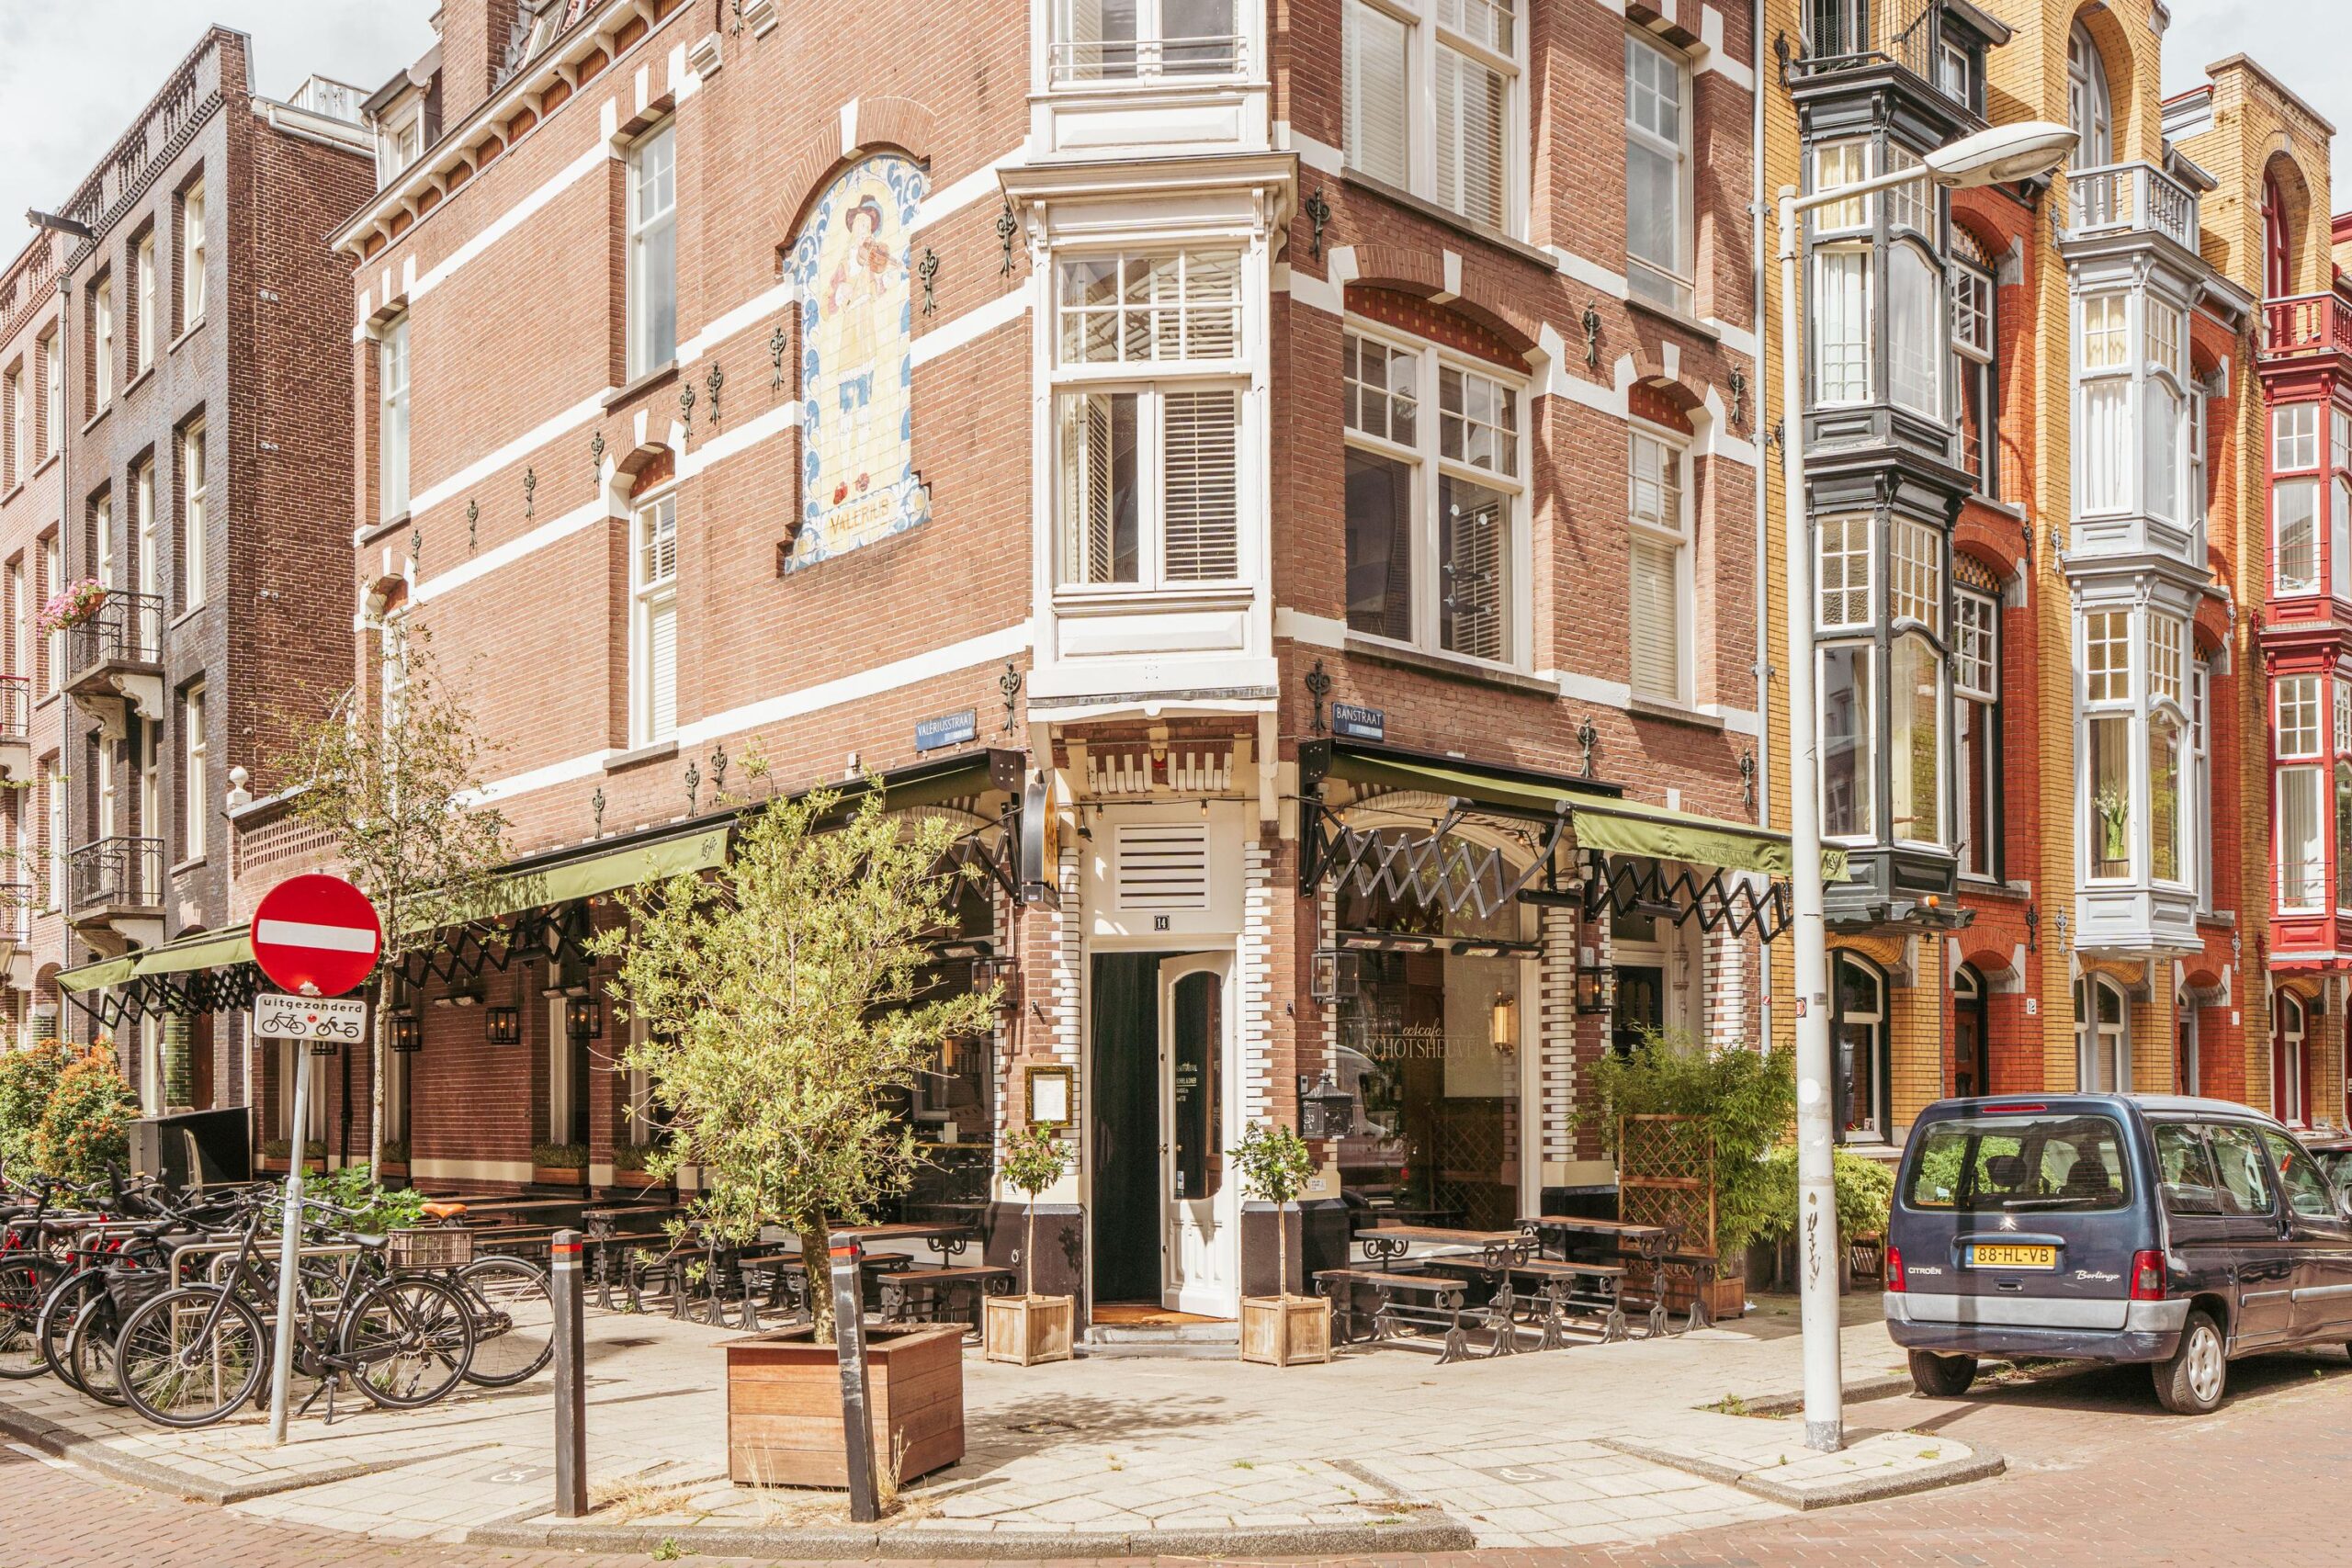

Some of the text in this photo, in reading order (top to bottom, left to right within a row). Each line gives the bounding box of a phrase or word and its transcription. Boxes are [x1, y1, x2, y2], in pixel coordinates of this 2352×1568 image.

[1336, 706, 1382, 726] BANSTRAAT
[917, 714, 973, 737] VALERIUSSTRAAT
[1157, 918, 1167, 929] 14
[264, 998, 362, 1013] uitgezonderd
[1402, 1018, 1443, 1044] eetcafe
[1978, 1247, 2049, 1263] 88-HL-VB
[1907, 1267, 1942, 1275] CITROËN
[2075, 1269, 2120, 1282] Berlingo
